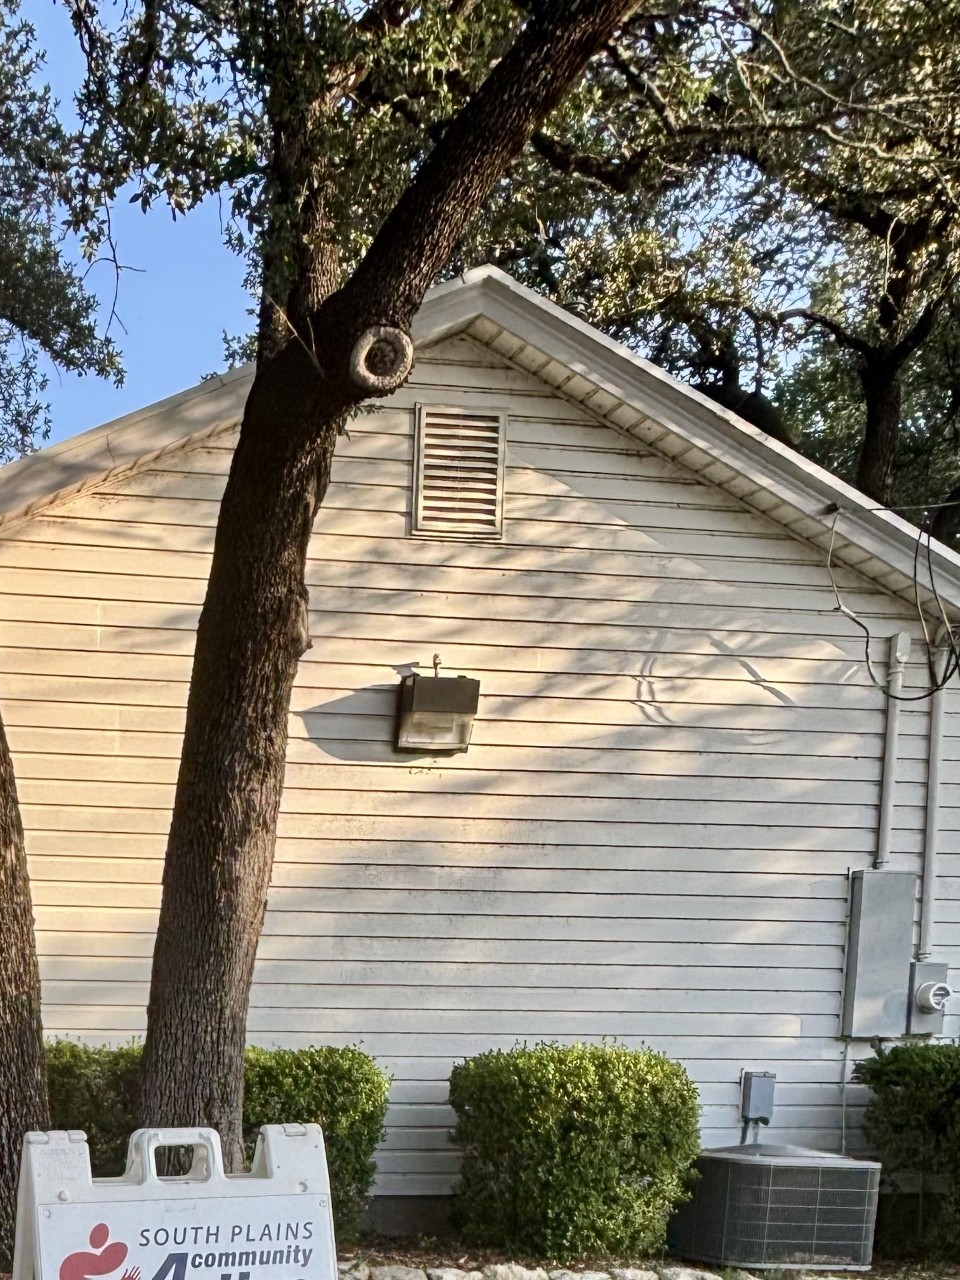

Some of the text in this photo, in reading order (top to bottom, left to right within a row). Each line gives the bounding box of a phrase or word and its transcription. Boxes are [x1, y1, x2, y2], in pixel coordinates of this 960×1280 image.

[138, 1221, 314, 1247] SOUTH PLAINS
[191, 1245, 313, 1268] community
